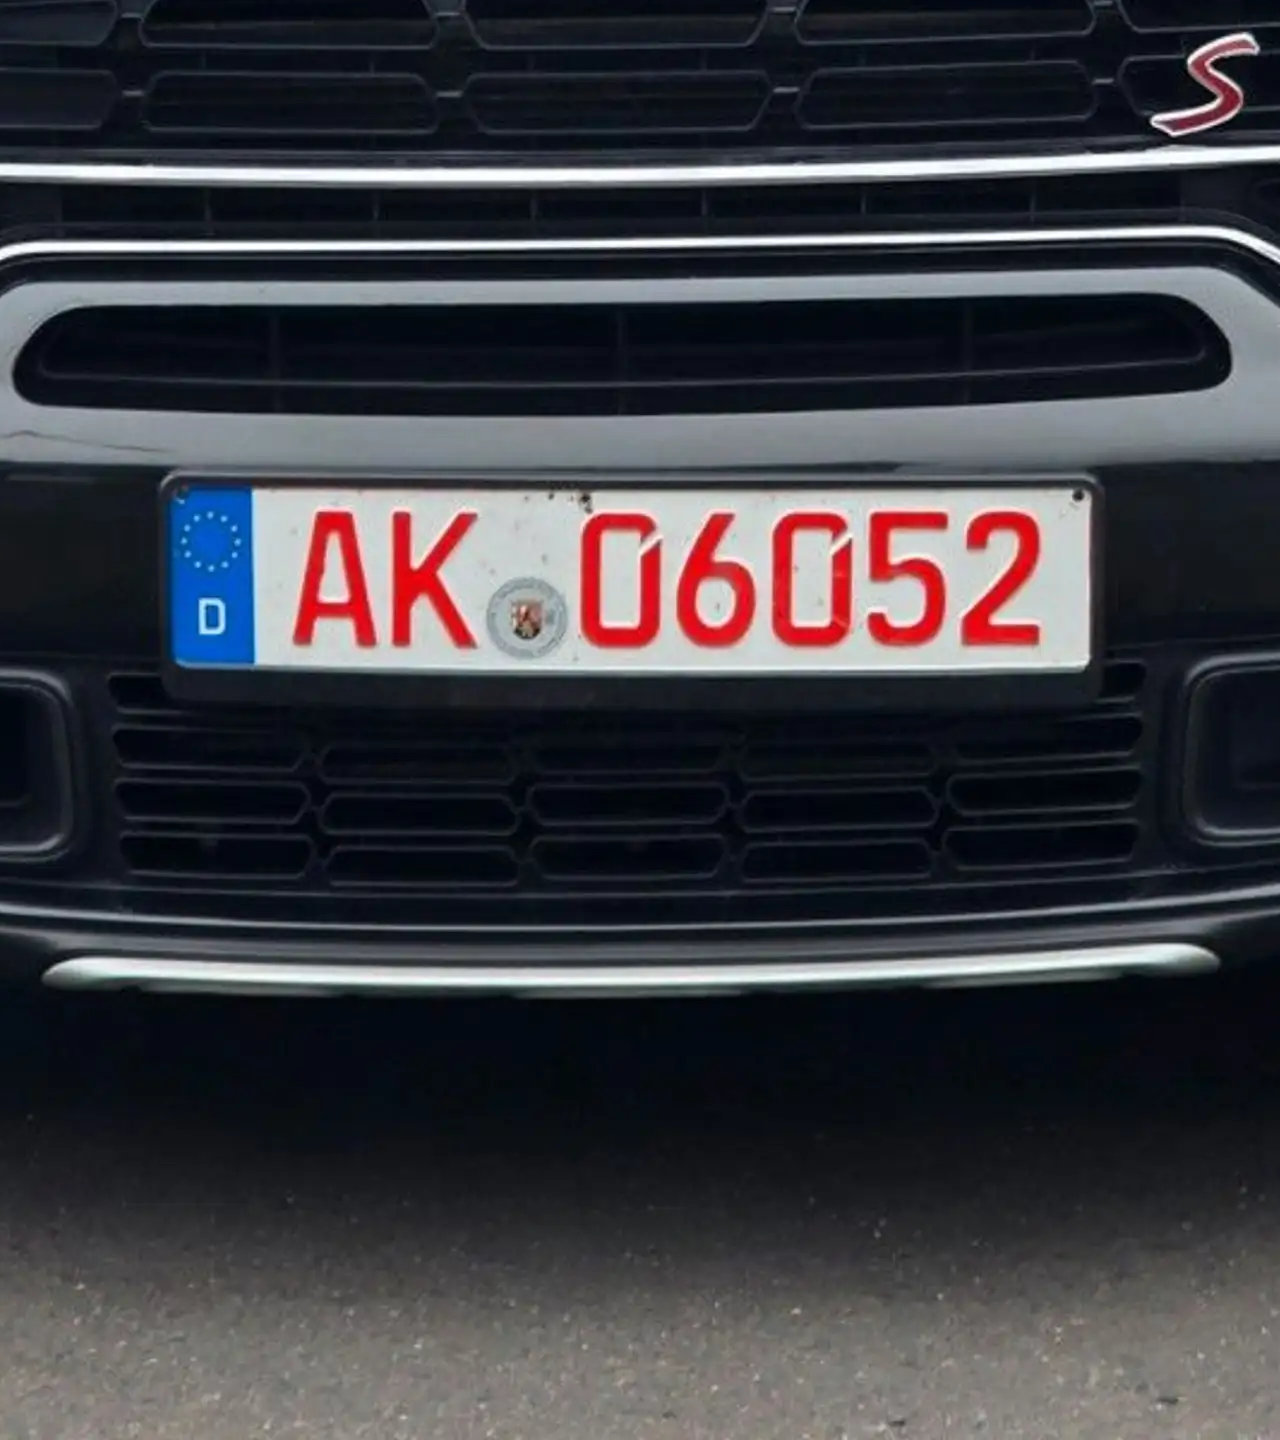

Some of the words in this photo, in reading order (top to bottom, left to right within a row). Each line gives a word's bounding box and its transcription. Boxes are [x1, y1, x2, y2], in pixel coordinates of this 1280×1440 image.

[1150, 32, 1261, 137] S
[198, 597, 227, 636] D
[292, 510, 479, 649] AK
[578, 510, 1042, 649] 06052
